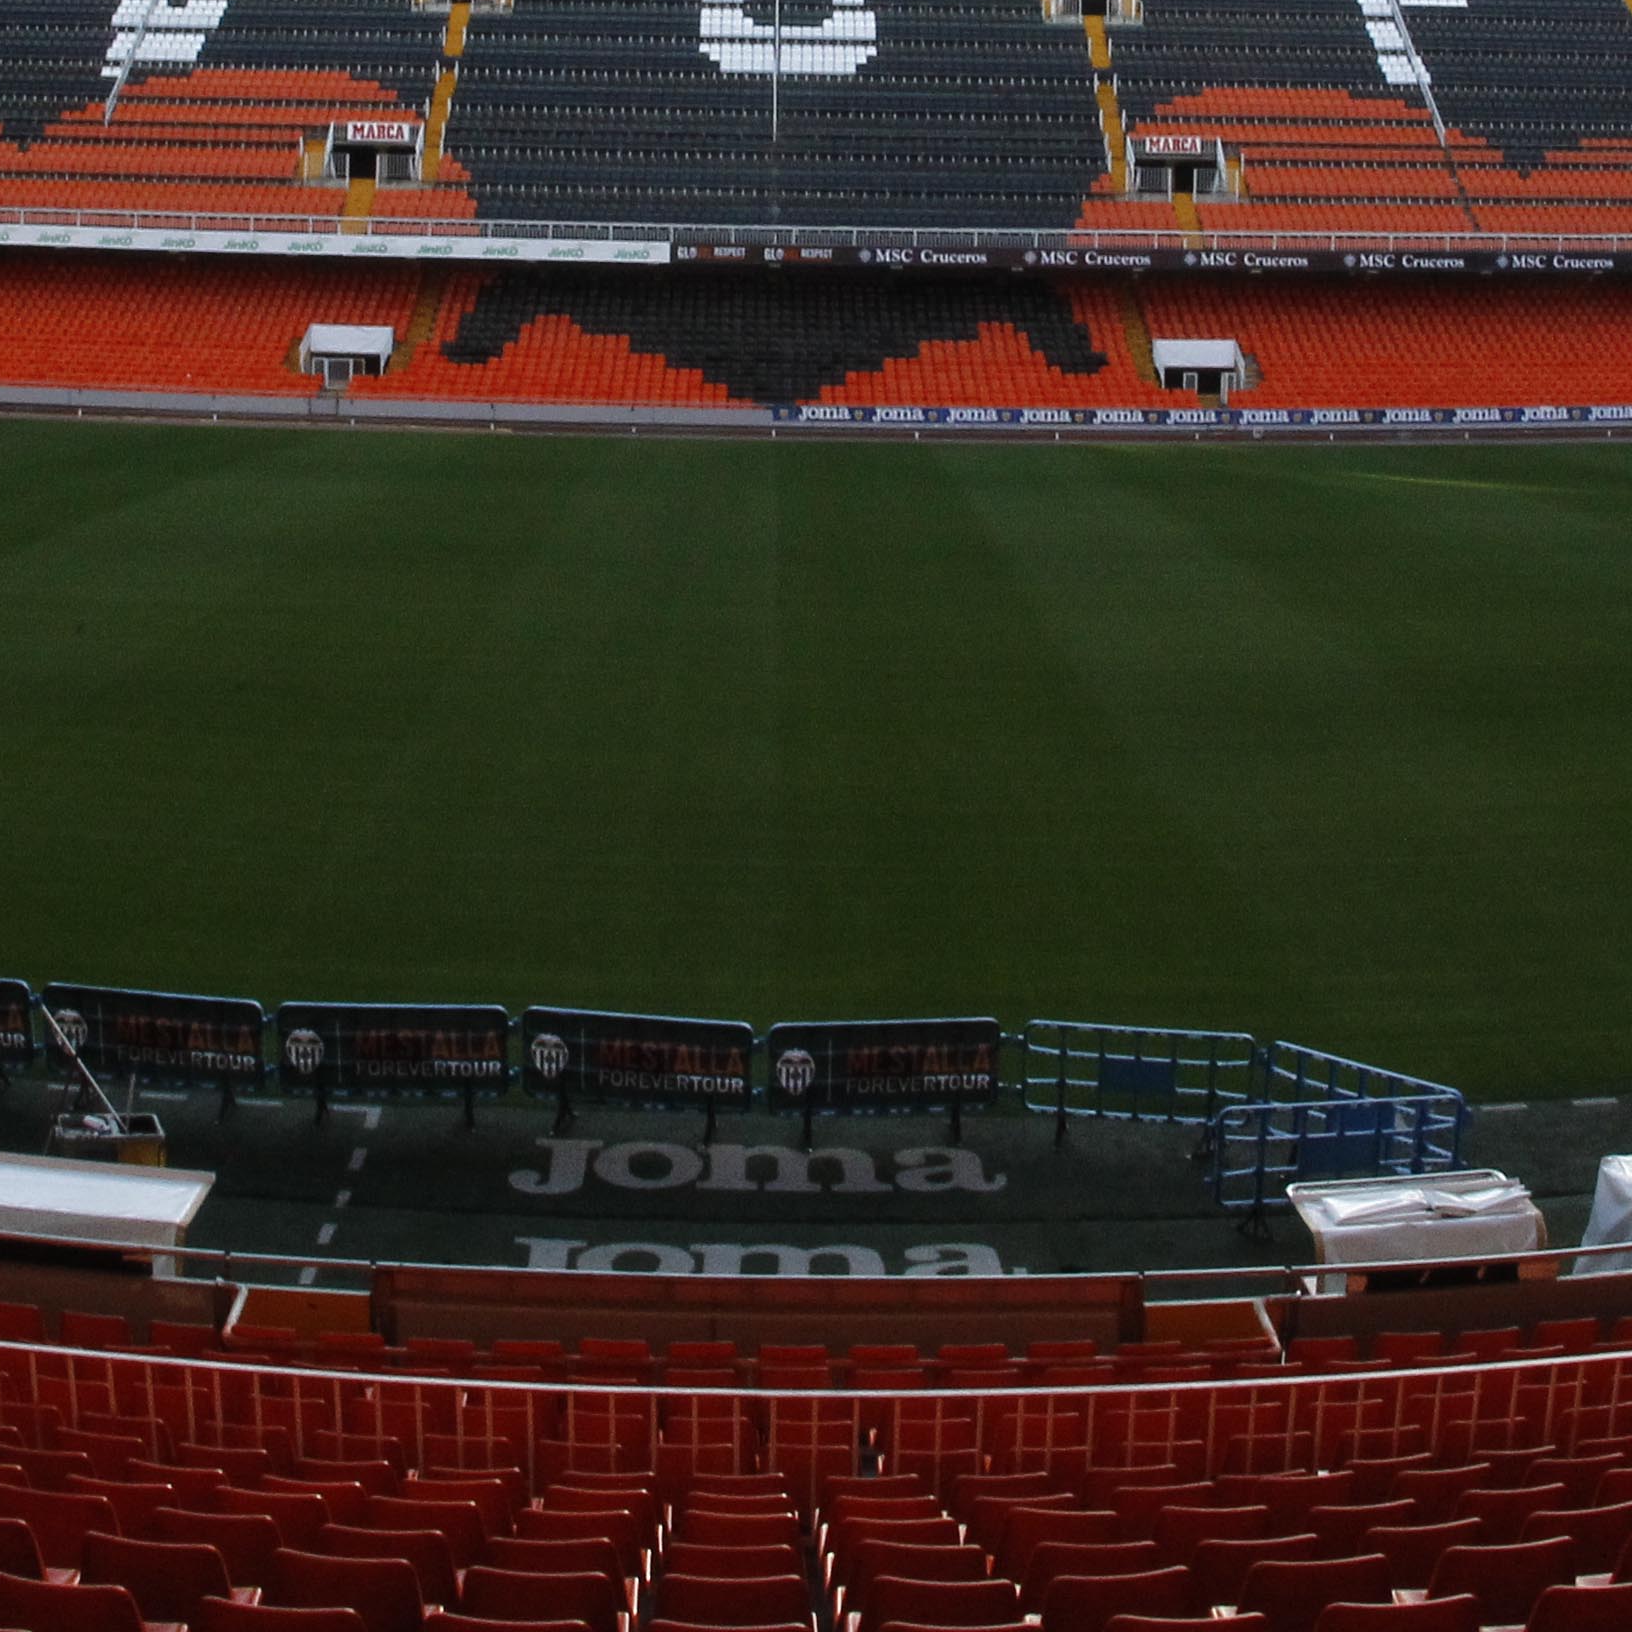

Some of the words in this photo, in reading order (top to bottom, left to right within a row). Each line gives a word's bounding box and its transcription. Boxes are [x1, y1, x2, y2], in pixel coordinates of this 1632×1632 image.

[352, 125, 404, 139] MARCA
[1148, 138, 1199, 153] MARCA
[876, 249, 913, 263] MSC
[921, 249, 987, 264] Cruceros
[1041, 251, 1078, 265] MSC
[1085, 252, 1151, 266] Cruceros
[1201, 252, 1237, 266] MSC
[1244, 252, 1308, 266] Cruceros
[1360, 254, 1395, 268] MSC
[1402, 254, 1465, 268] Cruceros
[1512, 254, 1547, 268] MSC
[1553, 255, 1614, 269] Cruceros
[509, 1138, 1006, 1194] Joma
